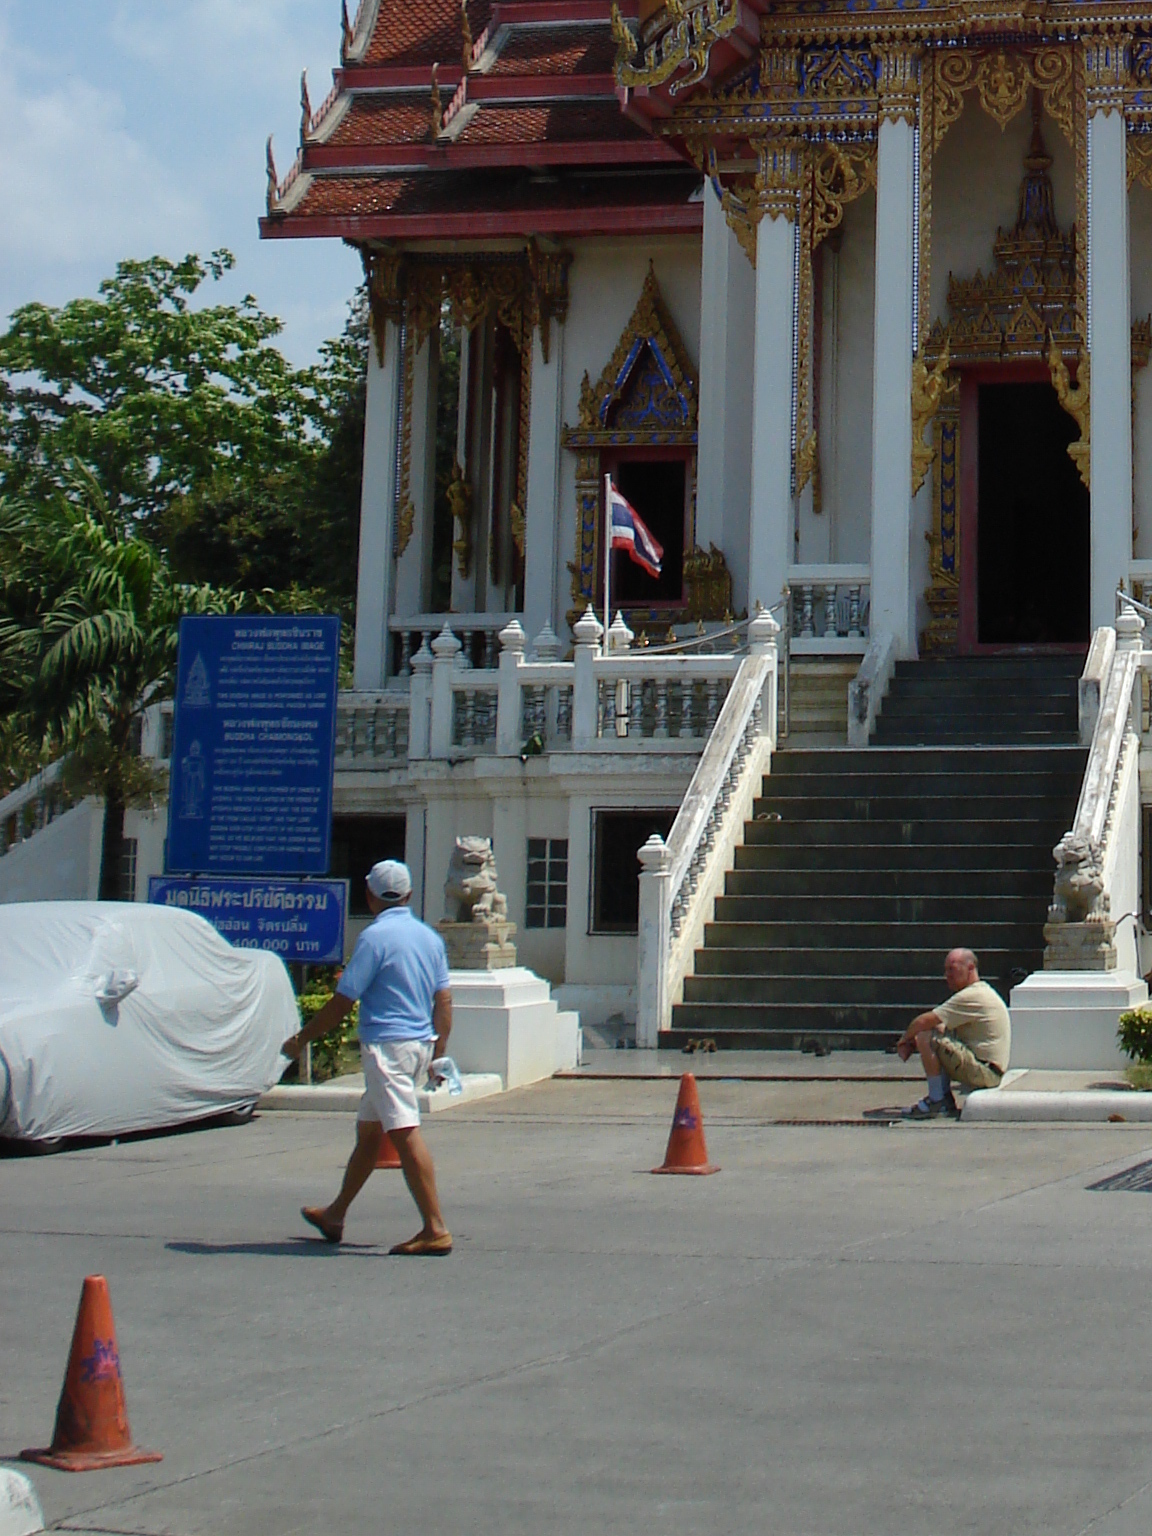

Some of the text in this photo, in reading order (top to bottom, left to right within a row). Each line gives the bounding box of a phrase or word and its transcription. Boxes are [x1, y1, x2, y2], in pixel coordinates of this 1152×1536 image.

[165, 886, 327, 911] มลนิธิพระปริยัติธรรม
[295, 940, 320, 952] บาท
